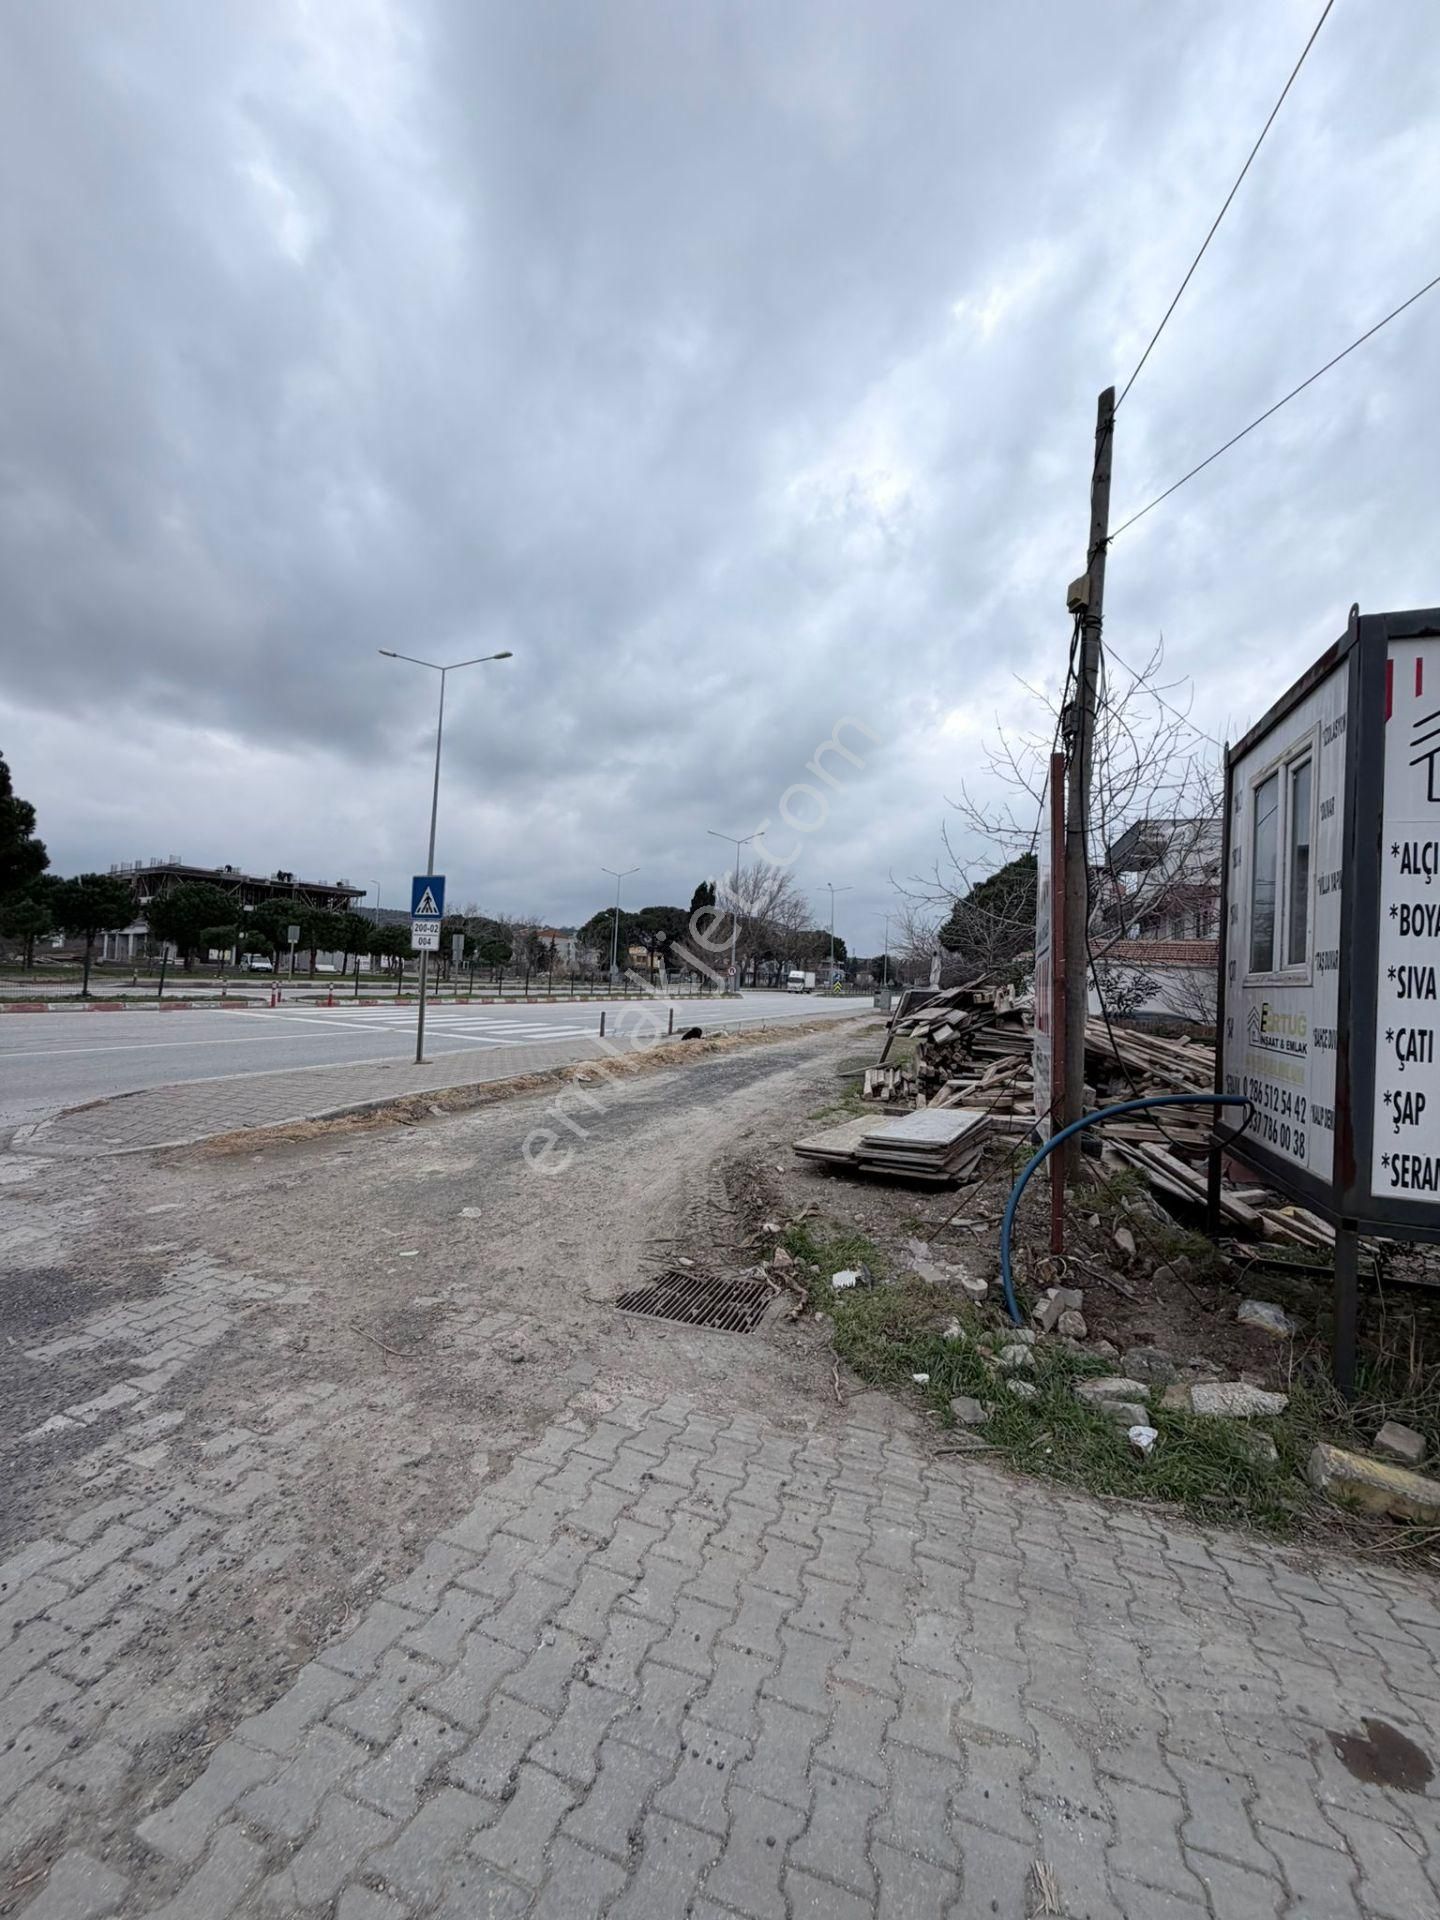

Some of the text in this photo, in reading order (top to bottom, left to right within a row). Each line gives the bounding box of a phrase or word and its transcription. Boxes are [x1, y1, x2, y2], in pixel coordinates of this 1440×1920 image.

[415, 923, 438, 933] 200-02
[418, 937, 431, 946] 004
[1286, 1040, 1307, 1055] EMLAK
[1243, 1075, 1248, 1096] 0
[1249, 1078, 1263, 1105] 286
[1264, 1083, 1279, 1112] 512
[1281, 1089, 1292, 1118] 54
[1294, 1095, 1307, 1125] 42
[1263, 1114, 1278, 1144] 786
[1280, 1122, 1291, 1151] 00
[1293, 1128, 1305, 1159] 38
